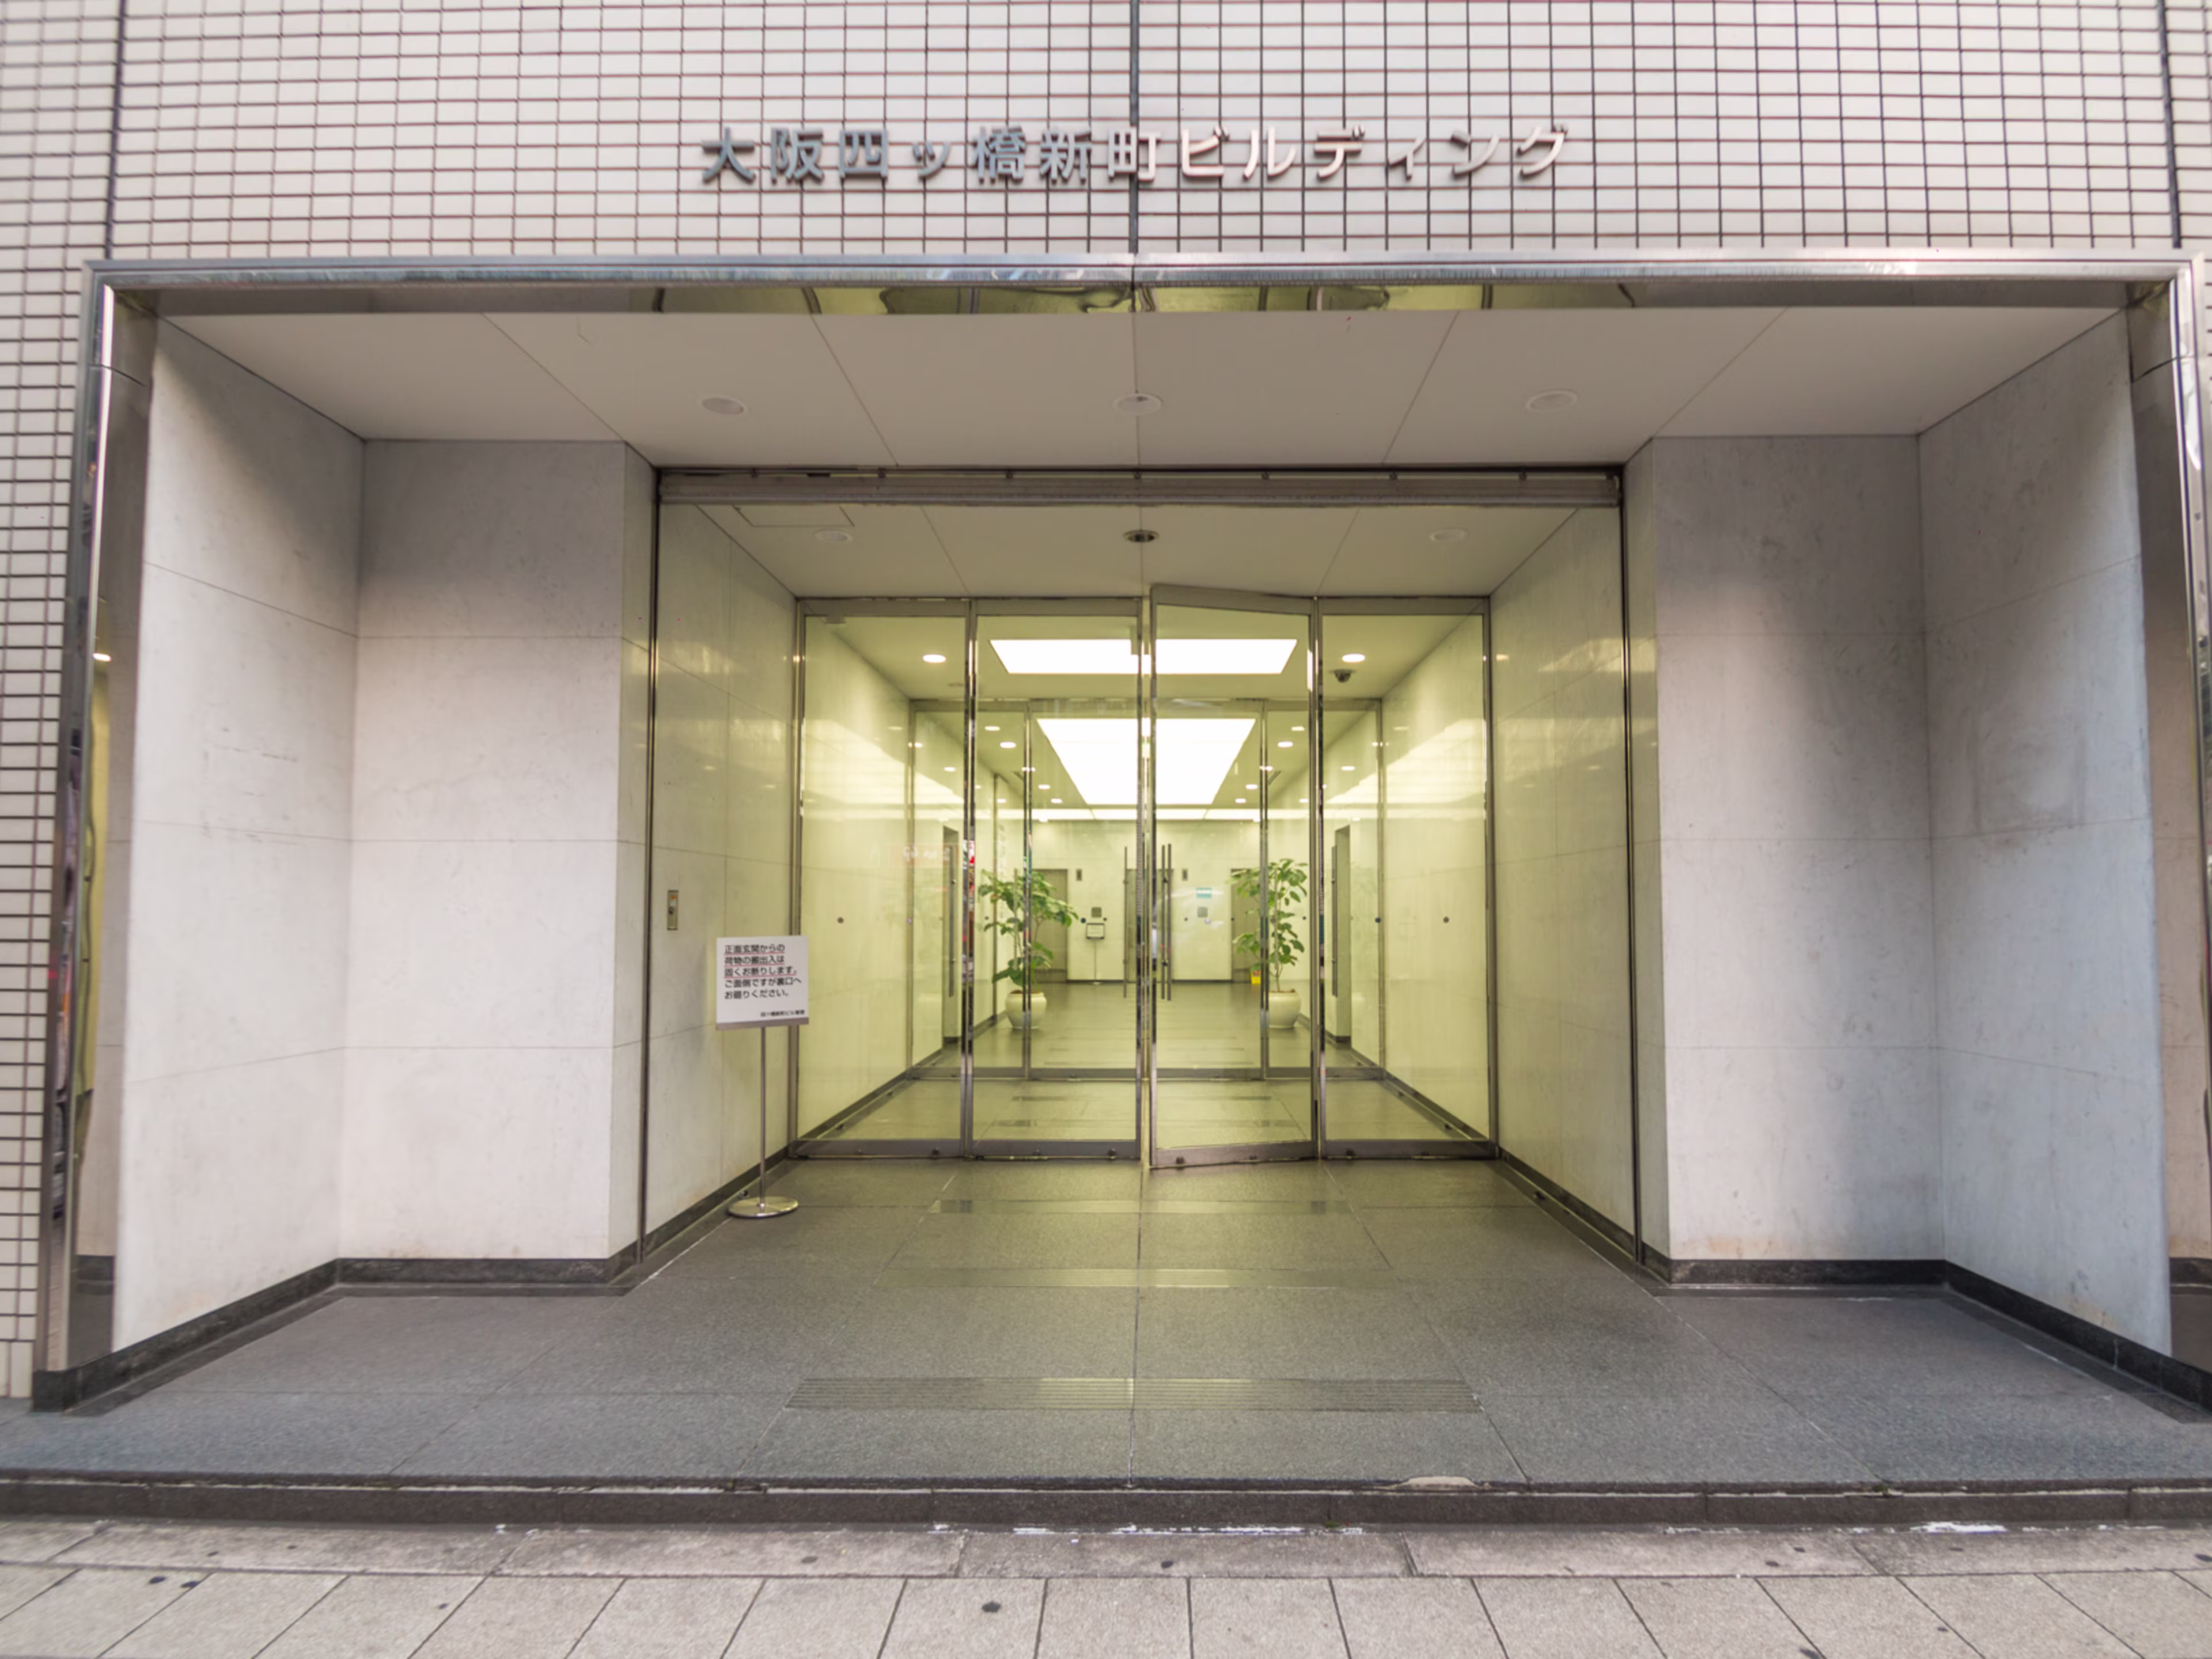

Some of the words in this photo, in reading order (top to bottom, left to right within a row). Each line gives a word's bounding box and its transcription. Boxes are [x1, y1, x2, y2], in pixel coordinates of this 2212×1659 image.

[724, 944, 785, 954] 正面玄関からの
